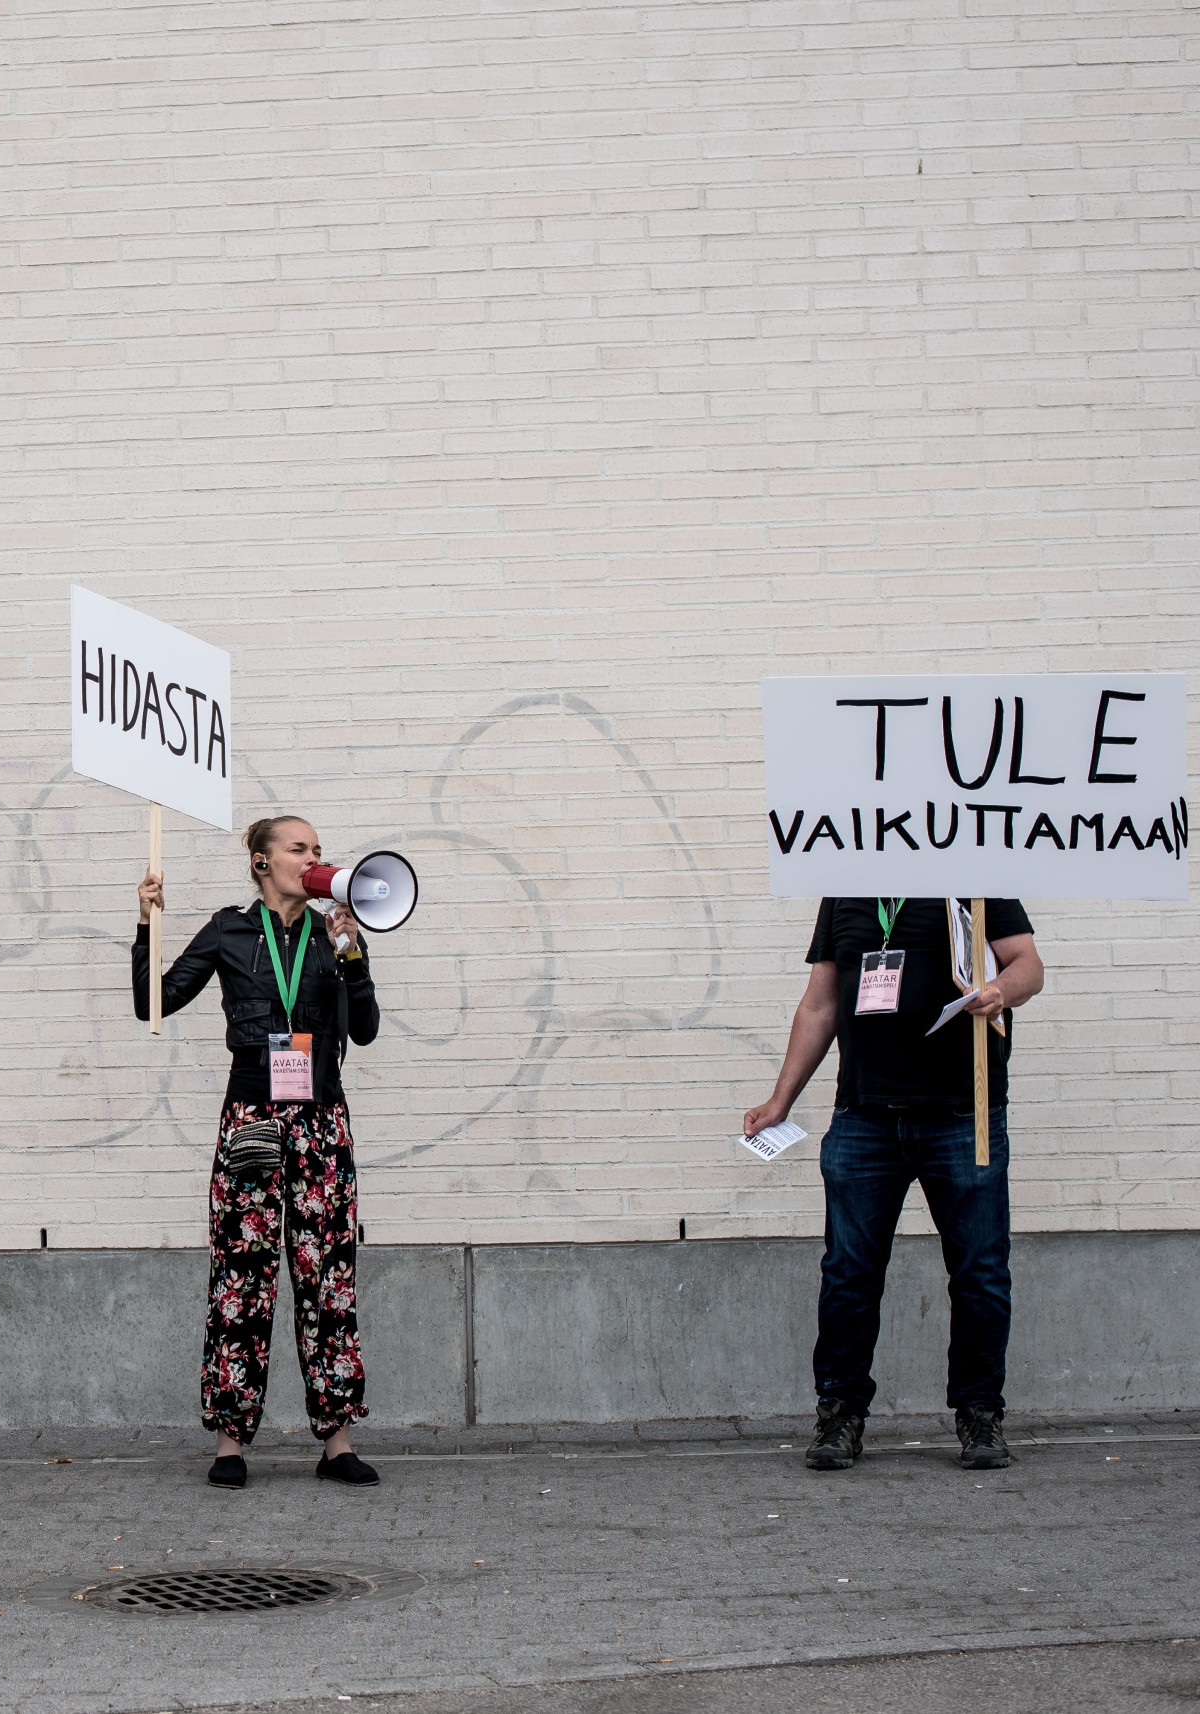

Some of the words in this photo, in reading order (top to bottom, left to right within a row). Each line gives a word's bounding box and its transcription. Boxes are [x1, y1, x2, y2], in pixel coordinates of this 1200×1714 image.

[81, 639, 227, 779] HIDASTA
[835, 689, 1146, 790] TULE
[768, 796, 1188, 860] VAIKUTTAMAAN
[862, 974, 897, 985] AVATAR
[272, 1058, 309, 1068] AVATAR
